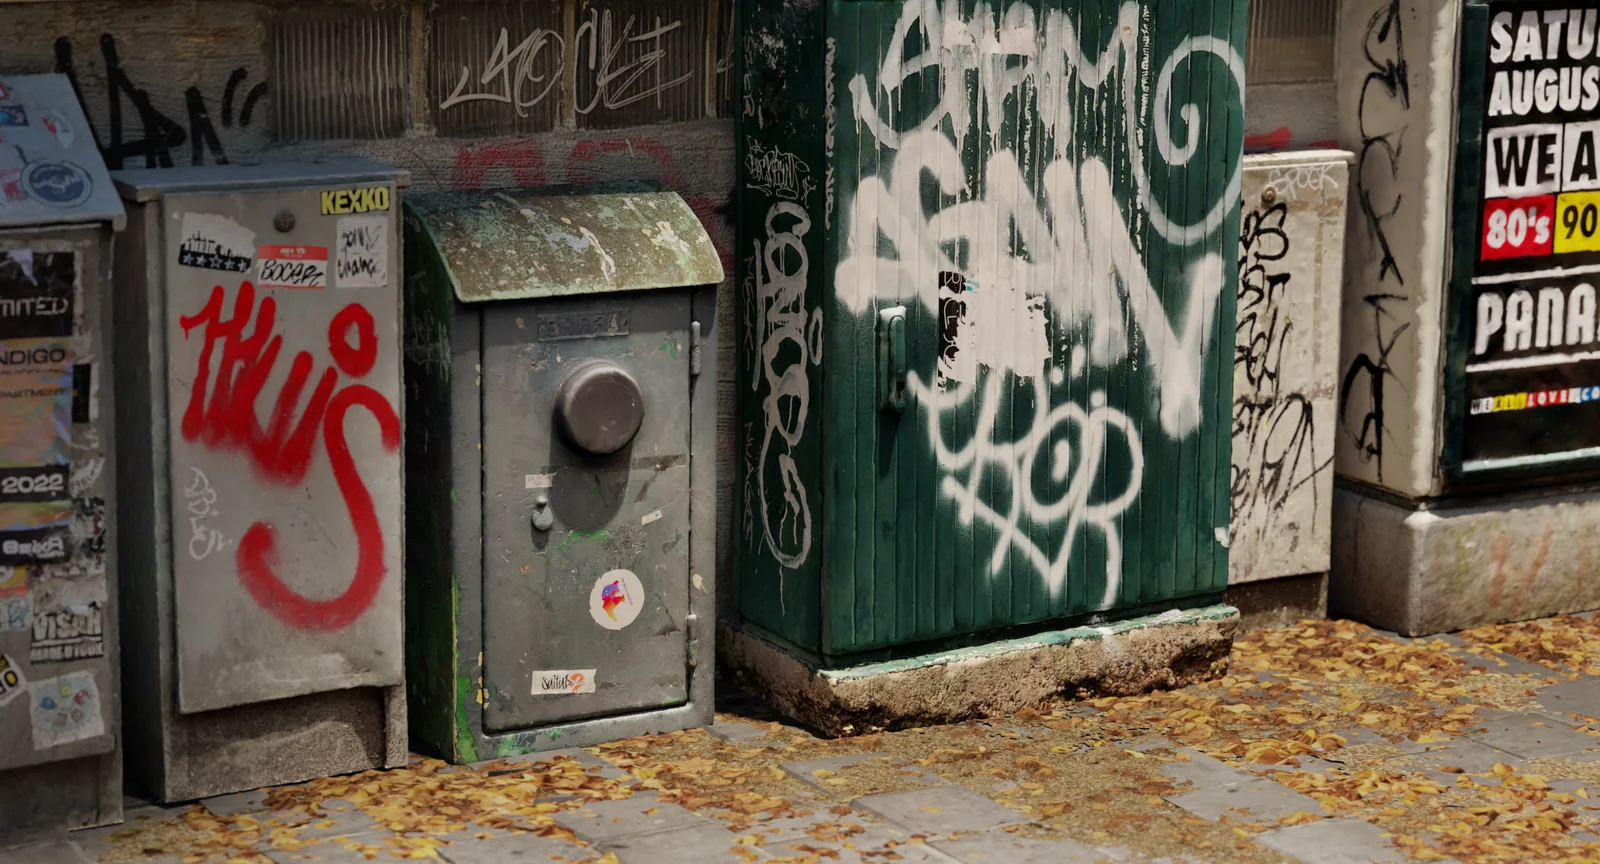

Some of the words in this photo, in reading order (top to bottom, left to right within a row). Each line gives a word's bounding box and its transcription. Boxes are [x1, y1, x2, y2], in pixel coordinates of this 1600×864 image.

[1490, 8, 1600, 63] SATU
[1493, 133, 1557, 188] WE
[321, 187, 390, 215] KEXKO
[1486, 206, 1550, 248] 80's
[1474, 283, 1600, 355] PANA
[1527, 390, 1568, 407] LOVE
[1, 472, 64, 495] 2022
